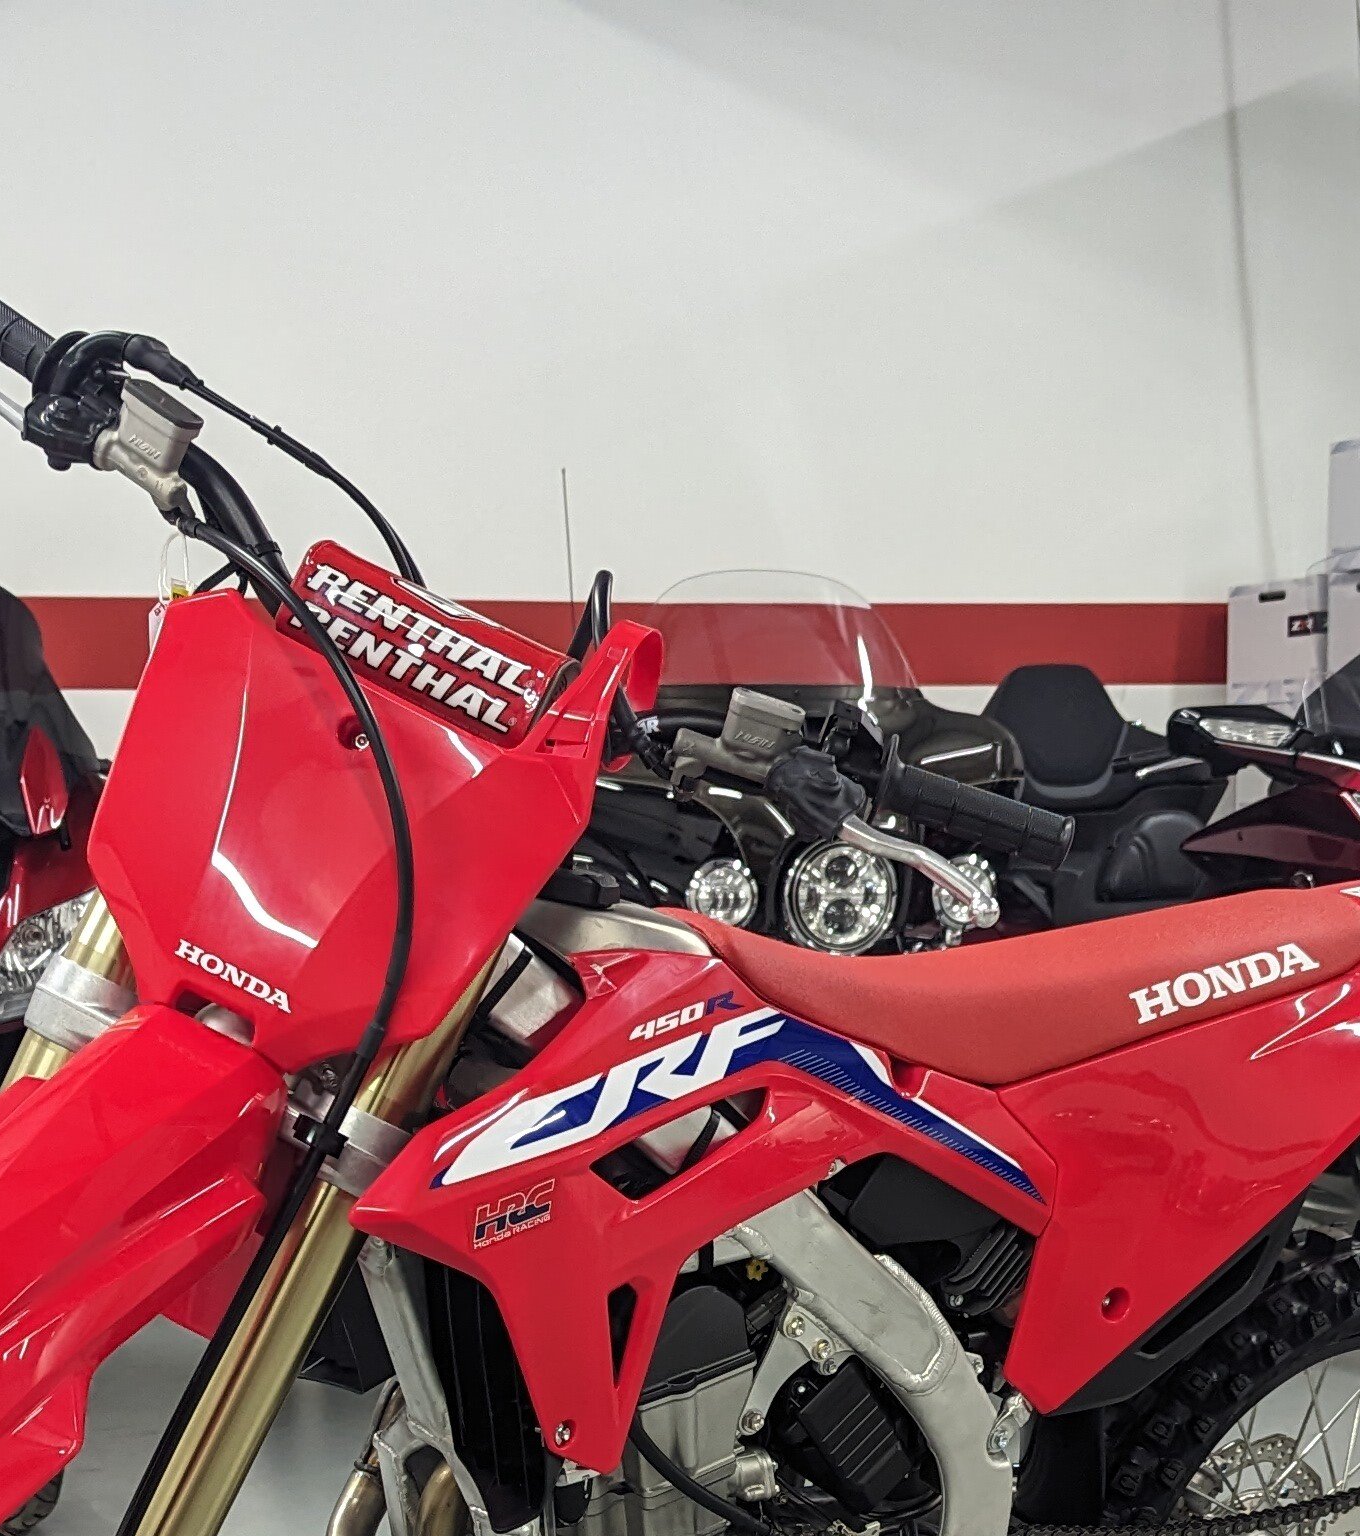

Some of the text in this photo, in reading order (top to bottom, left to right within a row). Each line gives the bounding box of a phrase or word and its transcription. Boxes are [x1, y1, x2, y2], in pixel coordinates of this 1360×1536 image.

[306, 563, 534, 696] RENTHAL
[174, 938, 292, 1014] HONDA
[1129, 942, 1320, 1025] HONDA
[629, 990, 746, 1043] 450R
[440, 1006, 788, 1187] CRF
[473, 1178, 556, 1243] HRC
[473, 1212, 552, 1250] Honda RACING
